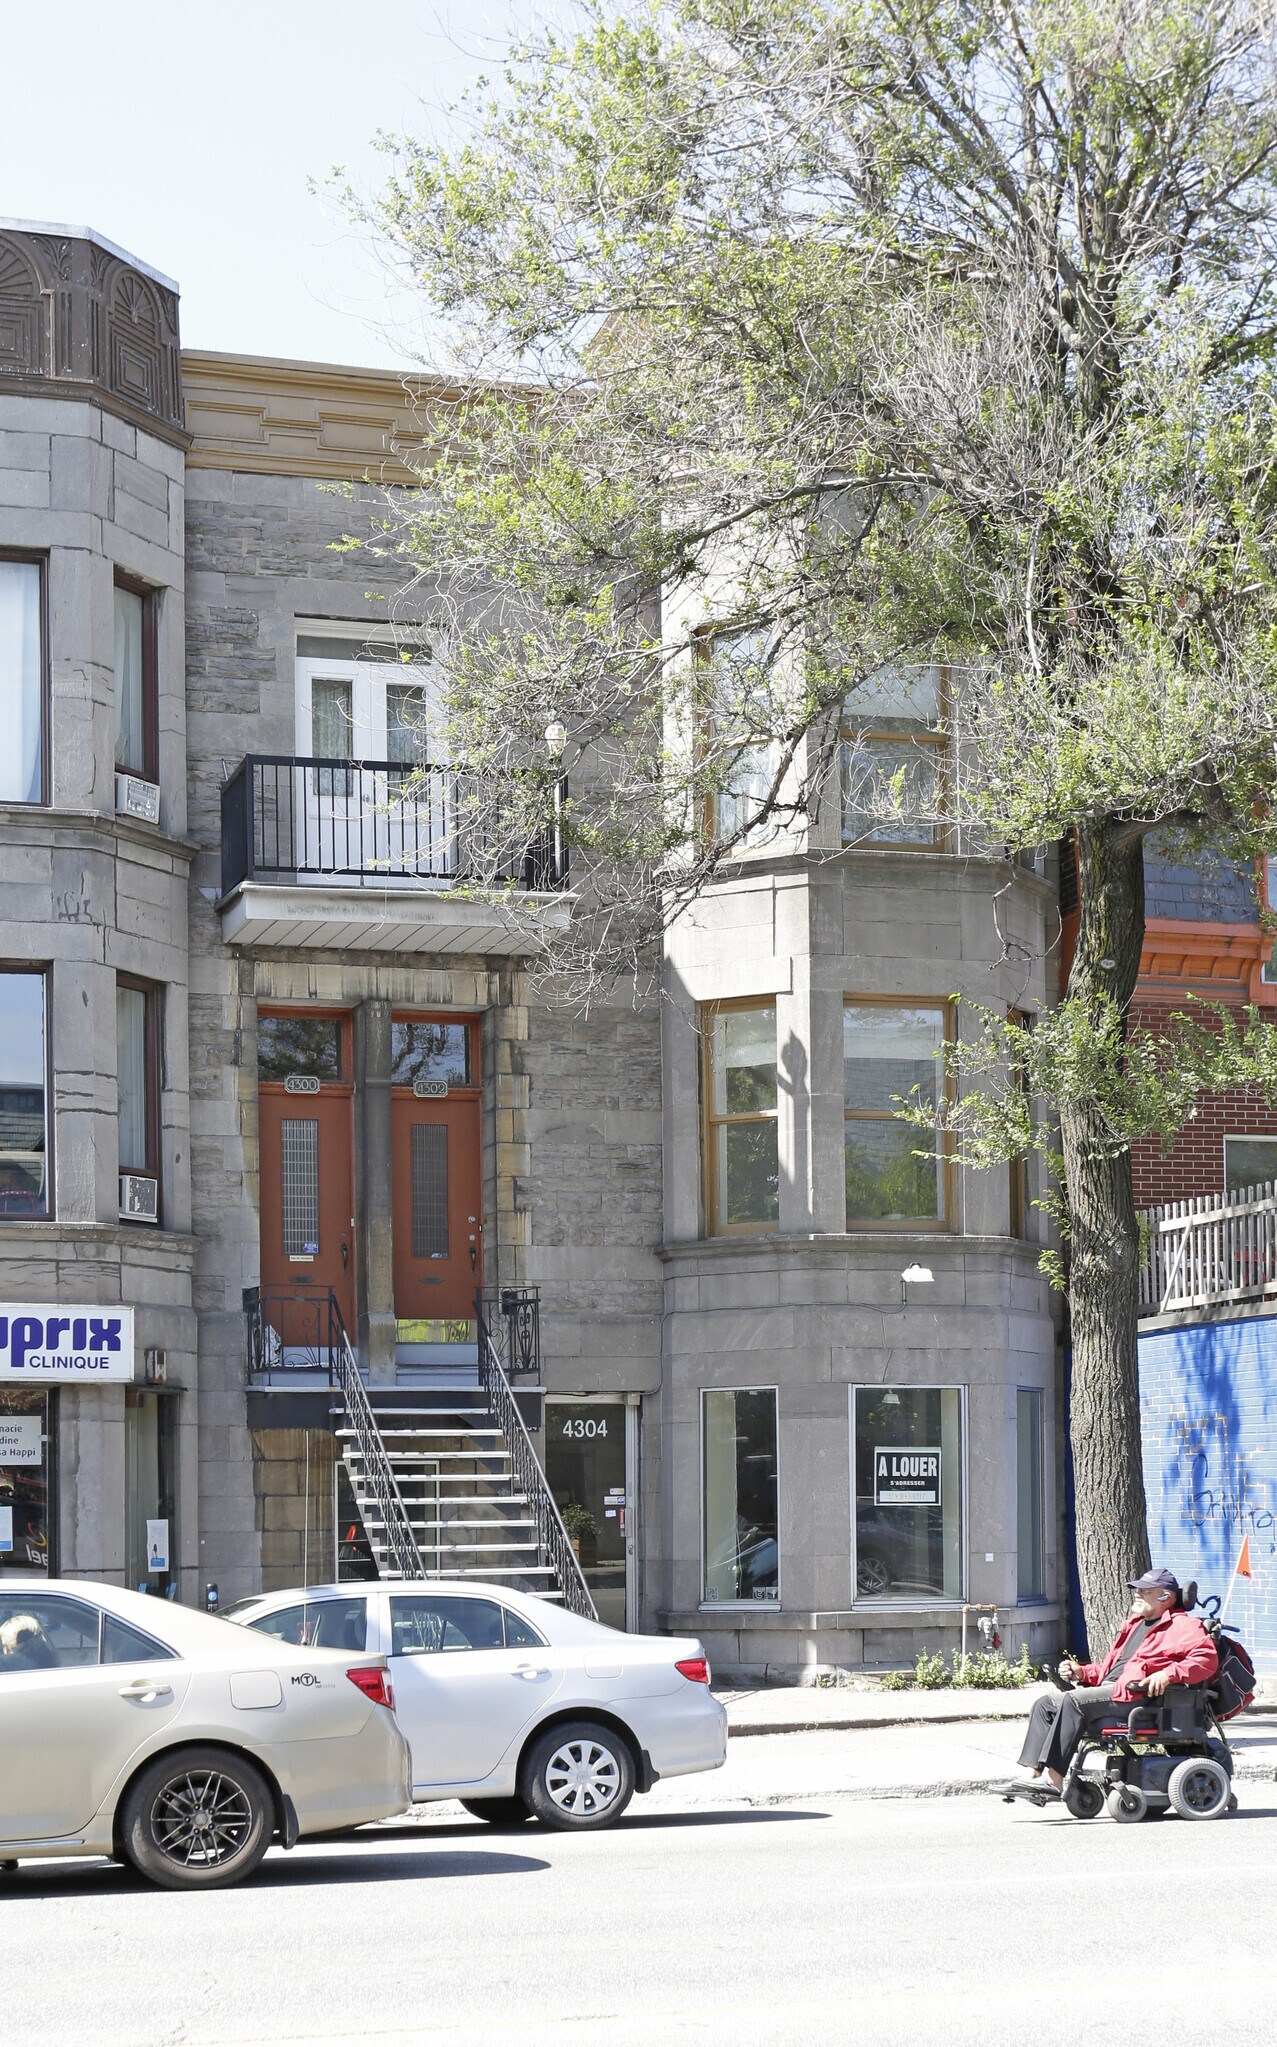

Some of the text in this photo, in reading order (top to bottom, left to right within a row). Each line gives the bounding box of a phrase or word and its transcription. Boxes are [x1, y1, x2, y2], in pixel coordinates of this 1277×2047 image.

[288, 1079, 317, 1090] 4300
[417, 1083, 445, 1094] 4302
[29, 1355, 110, 1369] CLINIQUE
[562, 1419, 608, 1438] 4304
[9, 1447, 36, 1458] Happi
[892, 1456, 938, 1477] LOUER
[291, 1672, 321, 1687] MTL
